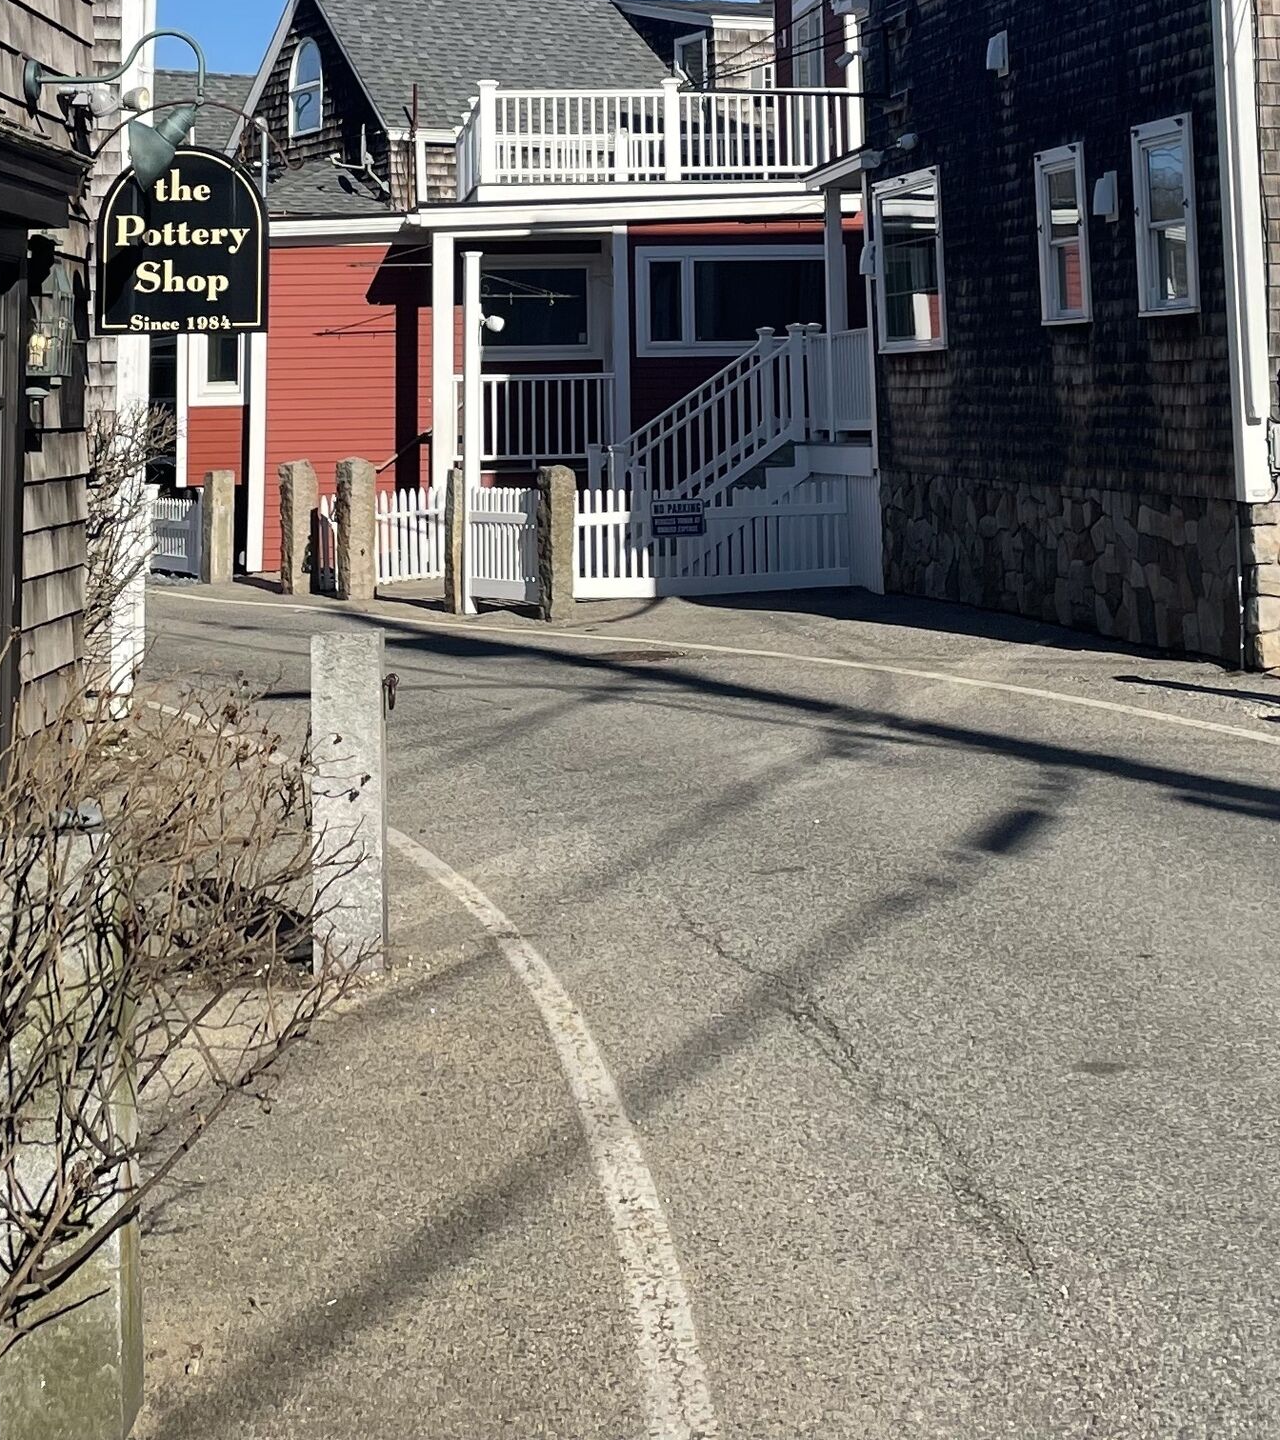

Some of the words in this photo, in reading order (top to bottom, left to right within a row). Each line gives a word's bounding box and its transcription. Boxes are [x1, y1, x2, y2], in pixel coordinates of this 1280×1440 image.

[153, 168, 211, 202] the
[115, 214, 251, 254] Pottery
[134, 259, 229, 301] Shop
[129, 314, 180, 331] Since
[186, 315, 232, 330] 1984
[653, 504, 665, 514] NO
[667, 503, 701, 514] PARKING
